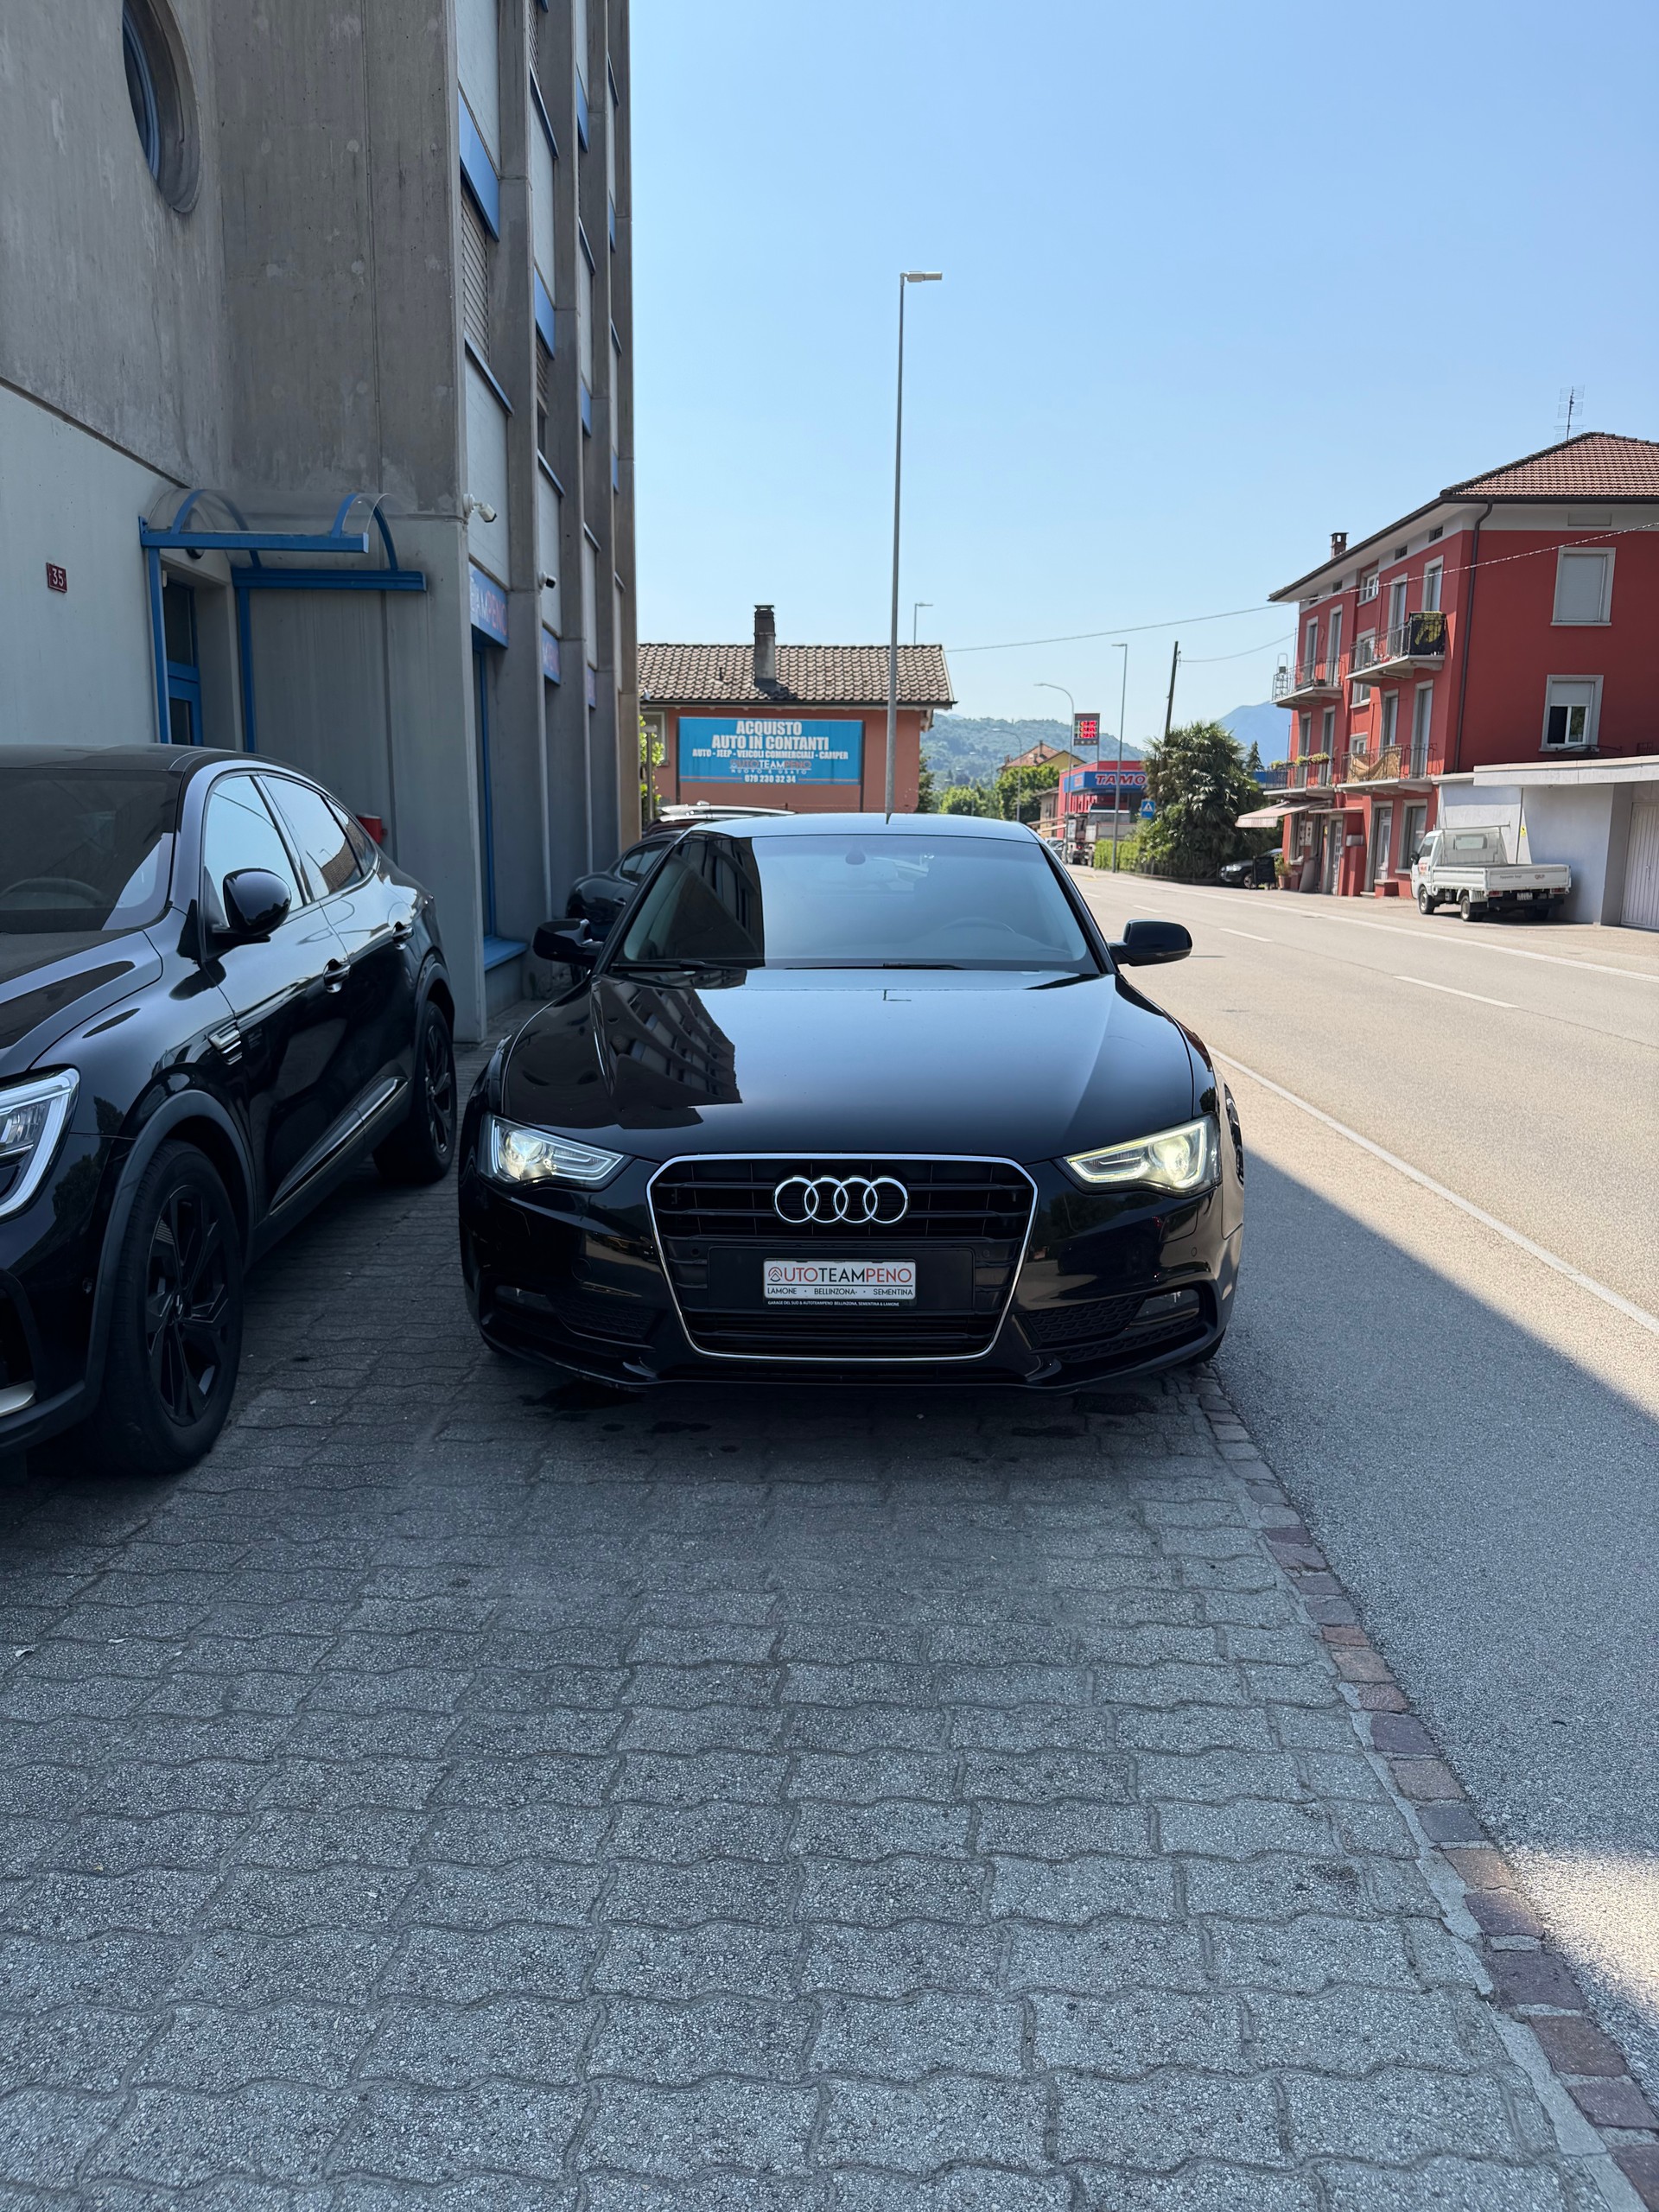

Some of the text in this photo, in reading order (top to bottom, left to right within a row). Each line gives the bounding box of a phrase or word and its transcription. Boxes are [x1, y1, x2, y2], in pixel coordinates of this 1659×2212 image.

[52, 568, 64, 587] 35
[736, 721, 803, 736] ACQUISTO
[712, 735, 830, 751] AUTO IN CONTANTI
[692, 748, 849, 760] AUTO JEEP VEICOLI COMMERCIALI CAMPER
